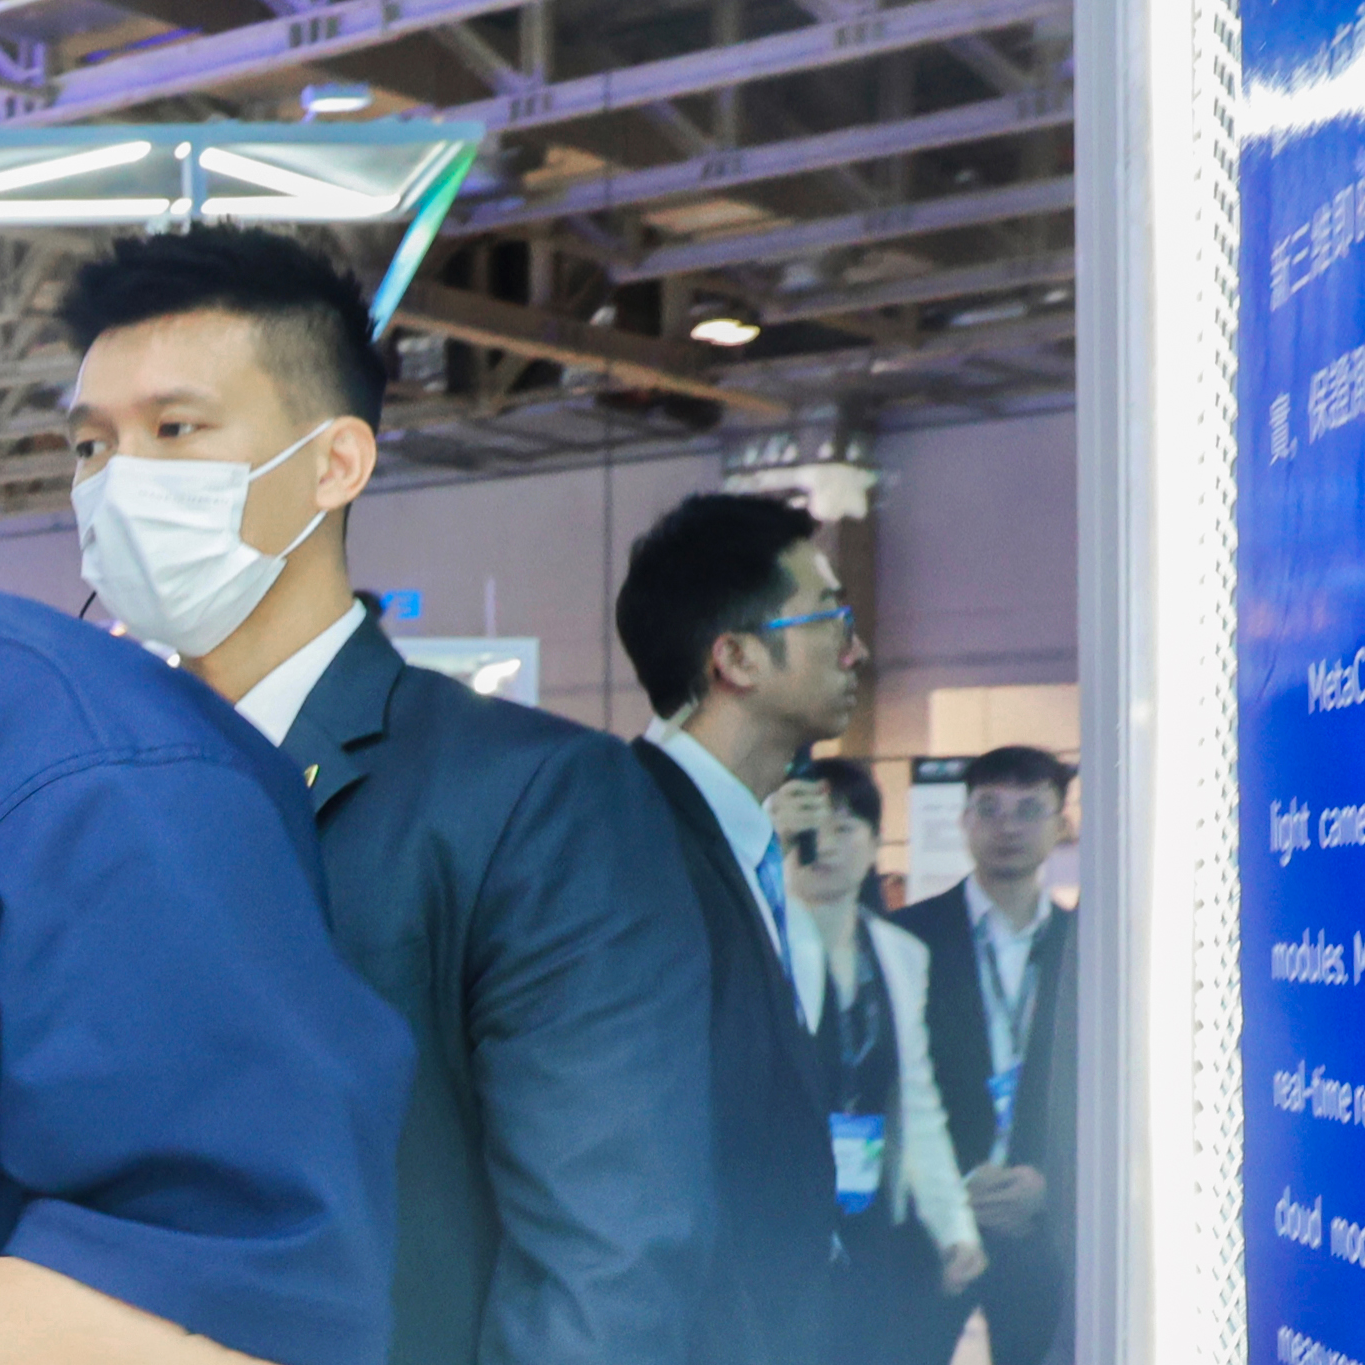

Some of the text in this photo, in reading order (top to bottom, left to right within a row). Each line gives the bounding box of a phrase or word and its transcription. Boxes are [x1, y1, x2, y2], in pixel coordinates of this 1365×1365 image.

[1270, 796, 1311, 868] light
[1273, 1060, 1352, 1125] real-time
[1275, 1185, 1322, 1250] cloud
